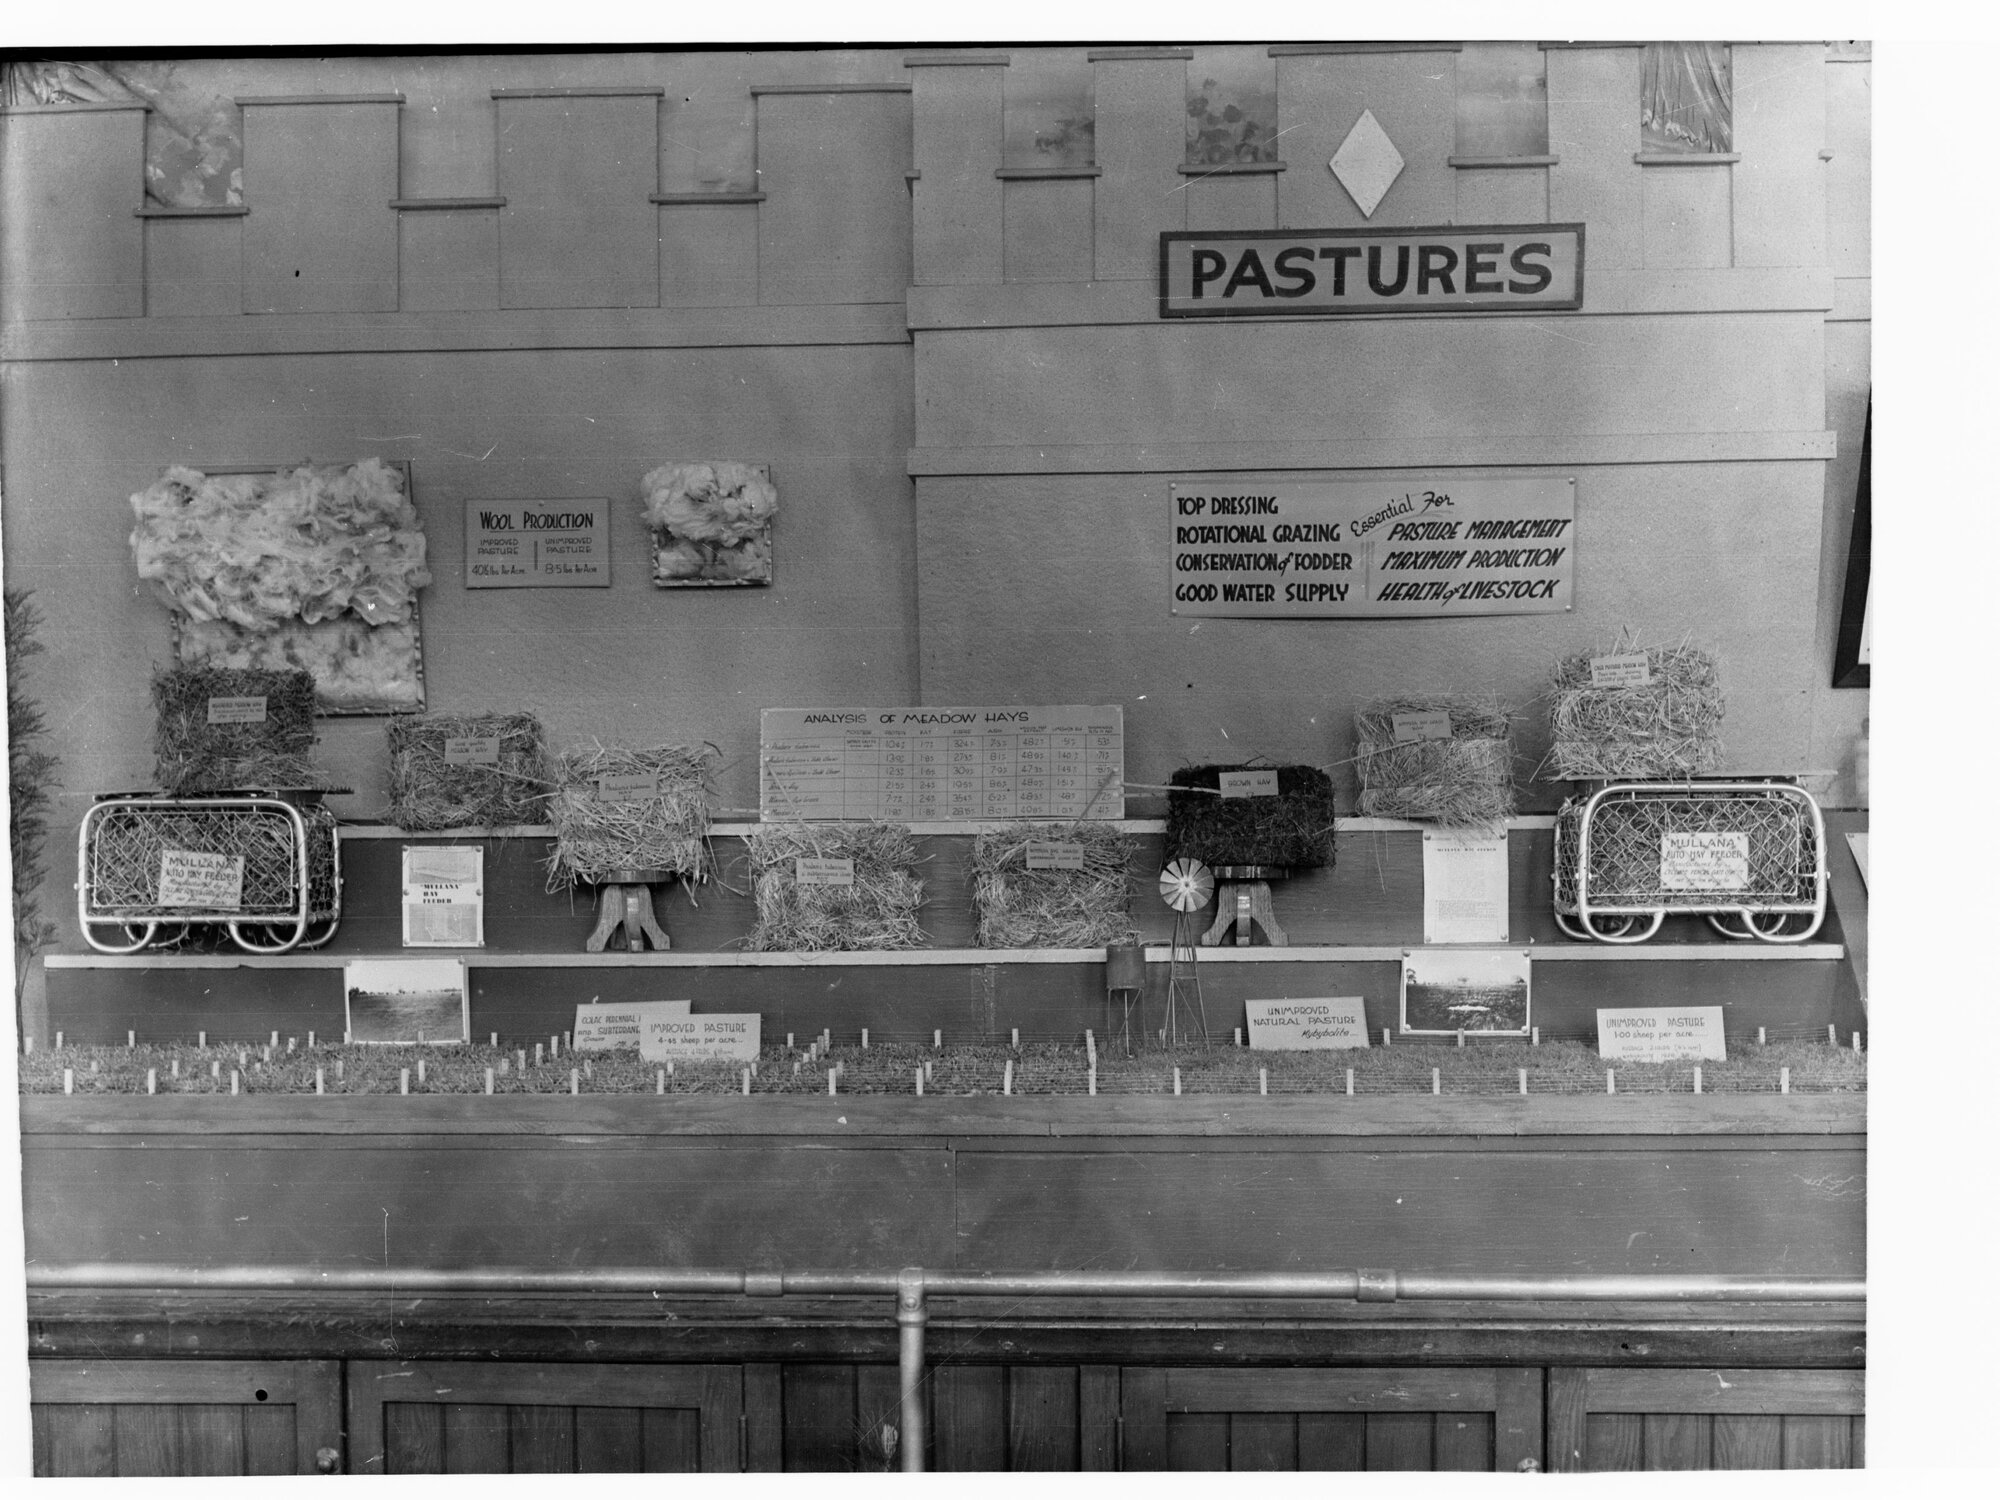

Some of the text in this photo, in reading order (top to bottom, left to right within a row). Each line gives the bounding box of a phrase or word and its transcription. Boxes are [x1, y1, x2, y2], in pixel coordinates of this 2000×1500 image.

[1191, 243, 1553, 299] PASTURES
[1177, 497, 1279, 515] TOP DRESSING
[1350, 491, 1455, 537] Essential For
[480, 511, 594, 529] WOOL PRODUCTION
[1177, 523, 1340, 544] ROTATIONAL GRAZING
[1387, 519, 1571, 541] PASTURE MANAGEMENT
[480, 538, 519, 546] IMPROVED
[545, 537, 593, 545] UNIMPROVED
[478, 547, 519, 555] PASTURE
[546, 545, 593, 554] PASTURE
[1176, 551, 1353, 576] CONSERVATION of FODDER
[1380, 547, 1565, 571] MAXIMUM PRODUCTION
[1176, 583, 1350, 602] GOOD WATER SUPPLY
[1377, 581, 1452, 602] HEALTH
[1459, 579, 1561, 601] LIVESTOCK
[804, 711, 1030, 724] ANALYSIS OF MEADOW HAYS
[1690, 851, 1705, 859] HAY
[1711, 850, 1742, 859] FEEDER
[1267, 1006, 1329, 1016] UNIMPROVED
[1254, 1016, 1356, 1026] NATURAL PASTURE
[1606, 1017, 1705, 1028] UNIMPROVED PASTURE
[598, 1025, 640, 1035] SUBTERRANE
[650, 1023, 747, 1033] IMPROVED PASTURE
[1301, 1028, 1350, 1040] Kybybolite
[1632, 1030, 1655, 1040] sheep
[1659, 1031, 1671, 1040] per
[681, 1035, 701, 1046] sheep
[705, 1037, 717, 1045] per
